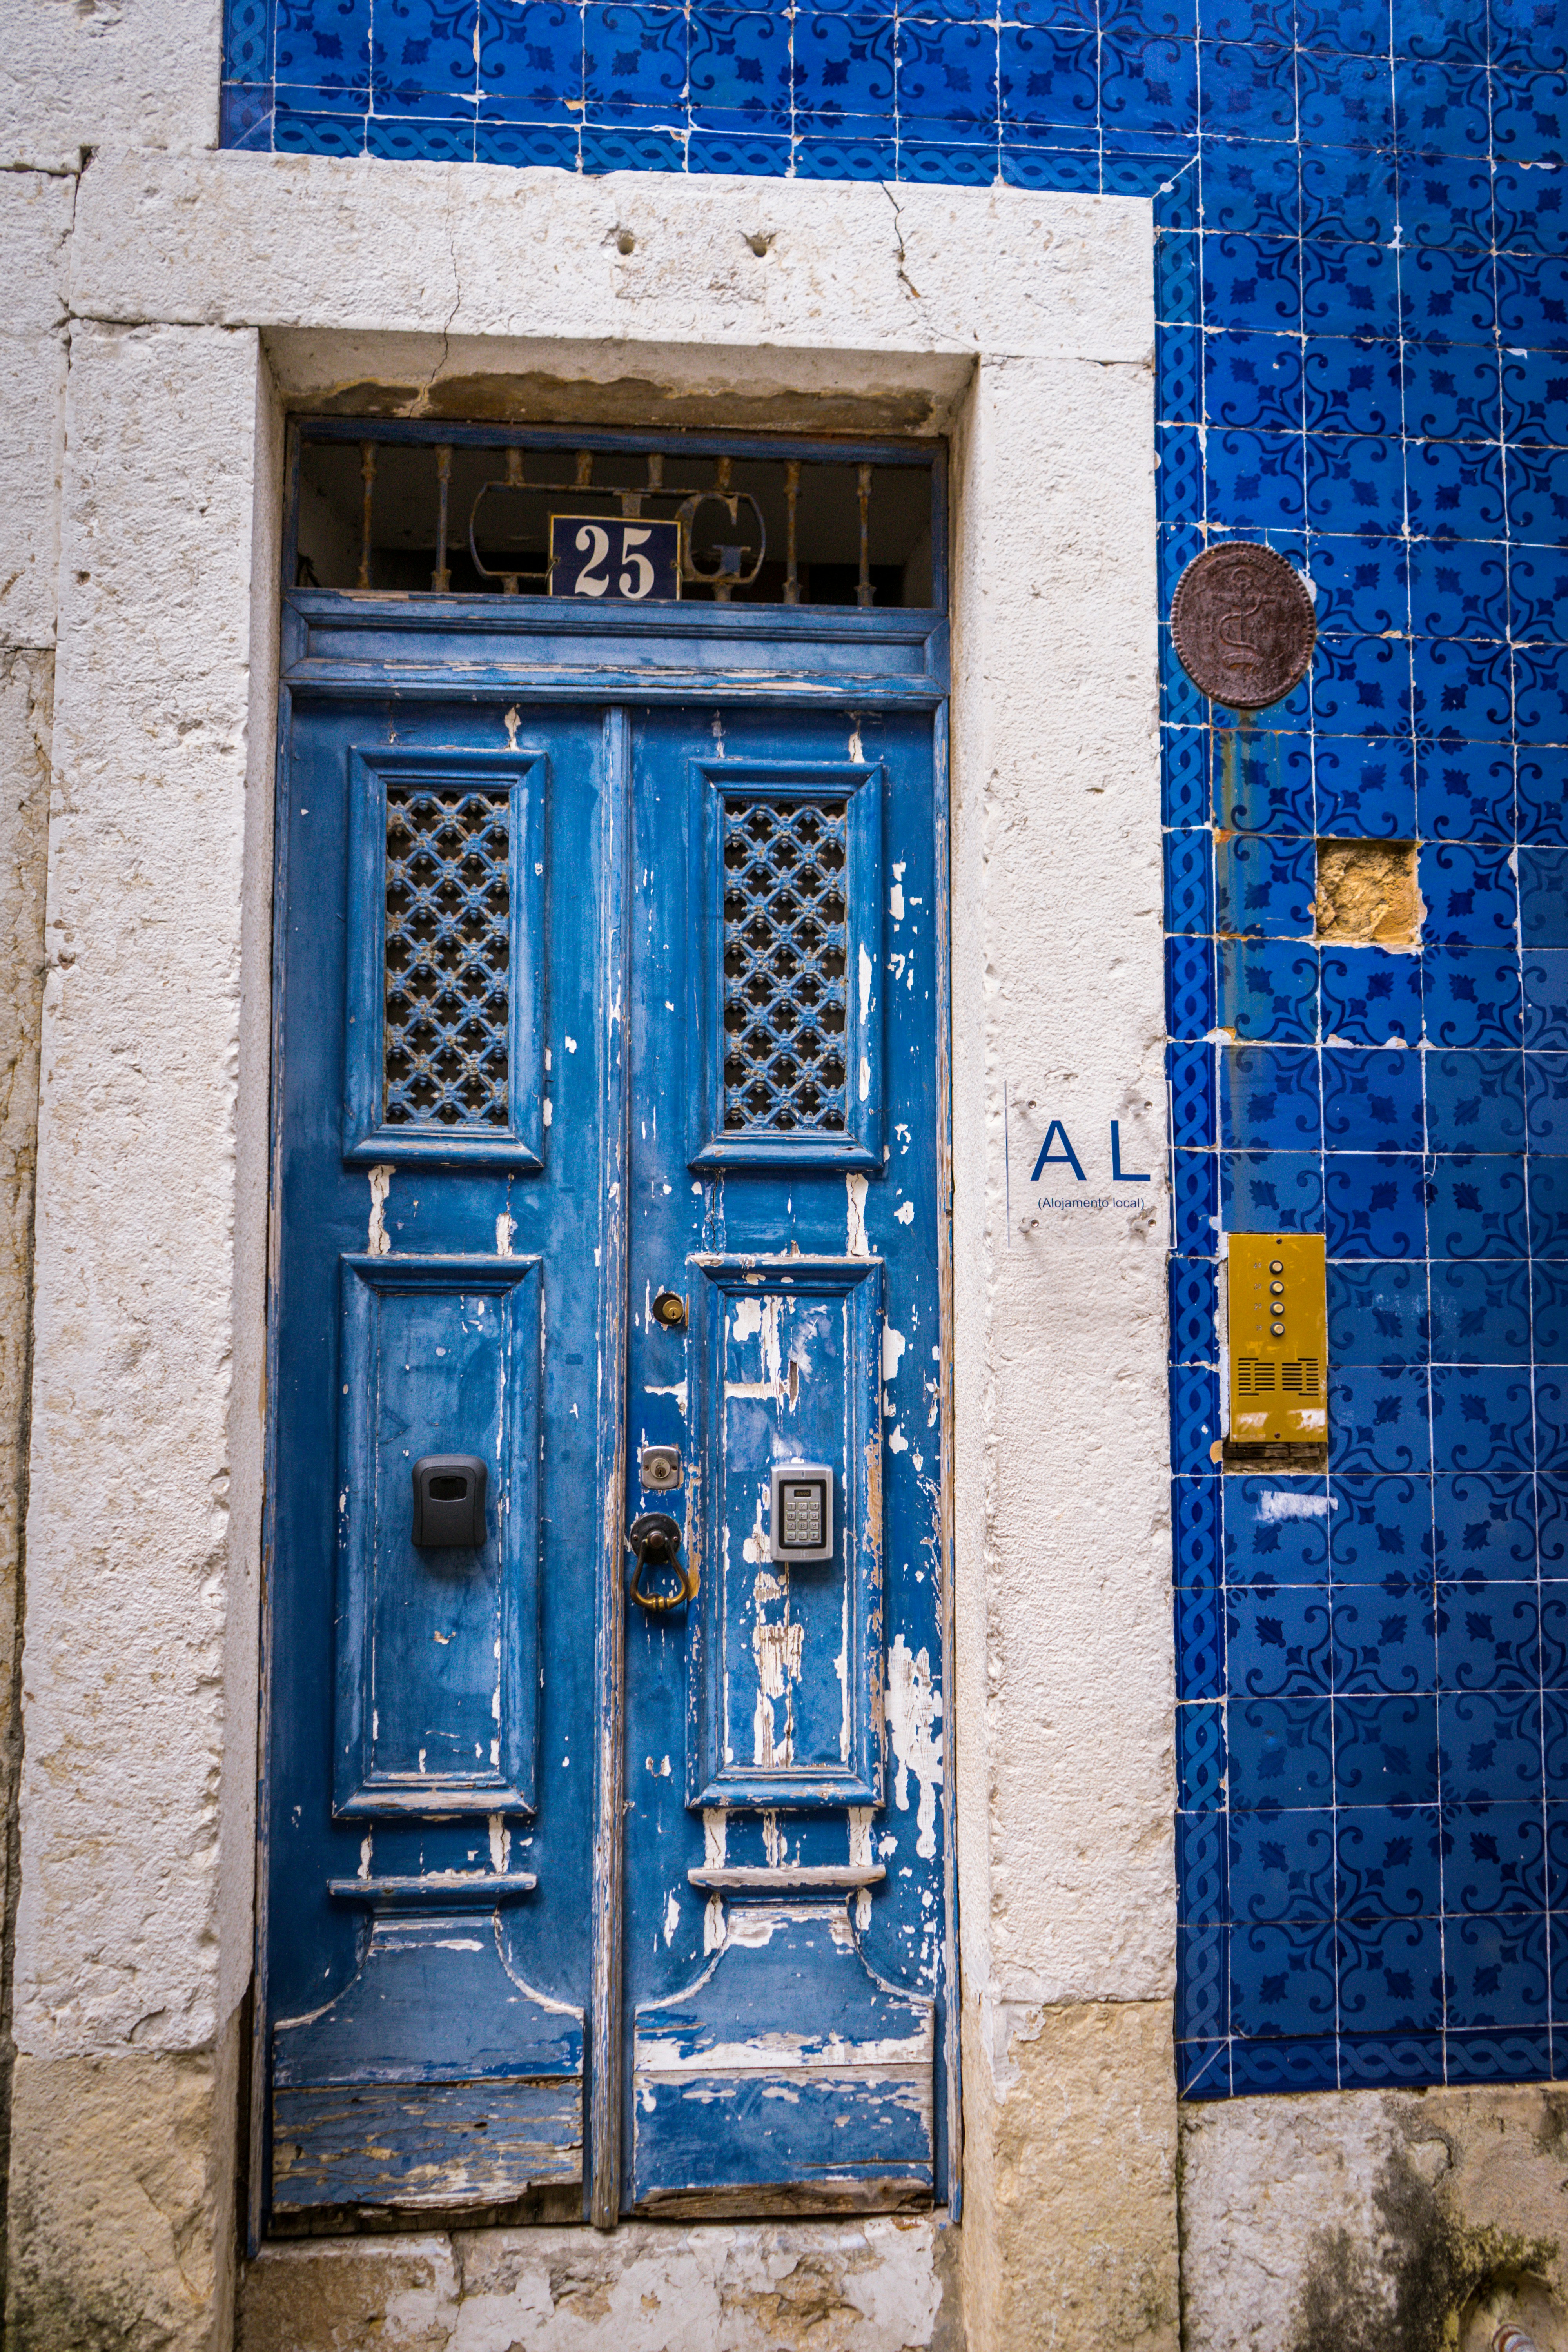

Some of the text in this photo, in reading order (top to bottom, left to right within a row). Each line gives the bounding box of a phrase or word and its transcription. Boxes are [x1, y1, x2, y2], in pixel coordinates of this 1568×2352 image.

[575, 525, 655, 599] 25
[1038, 1198, 1145, 1210] (Alojamento local)
